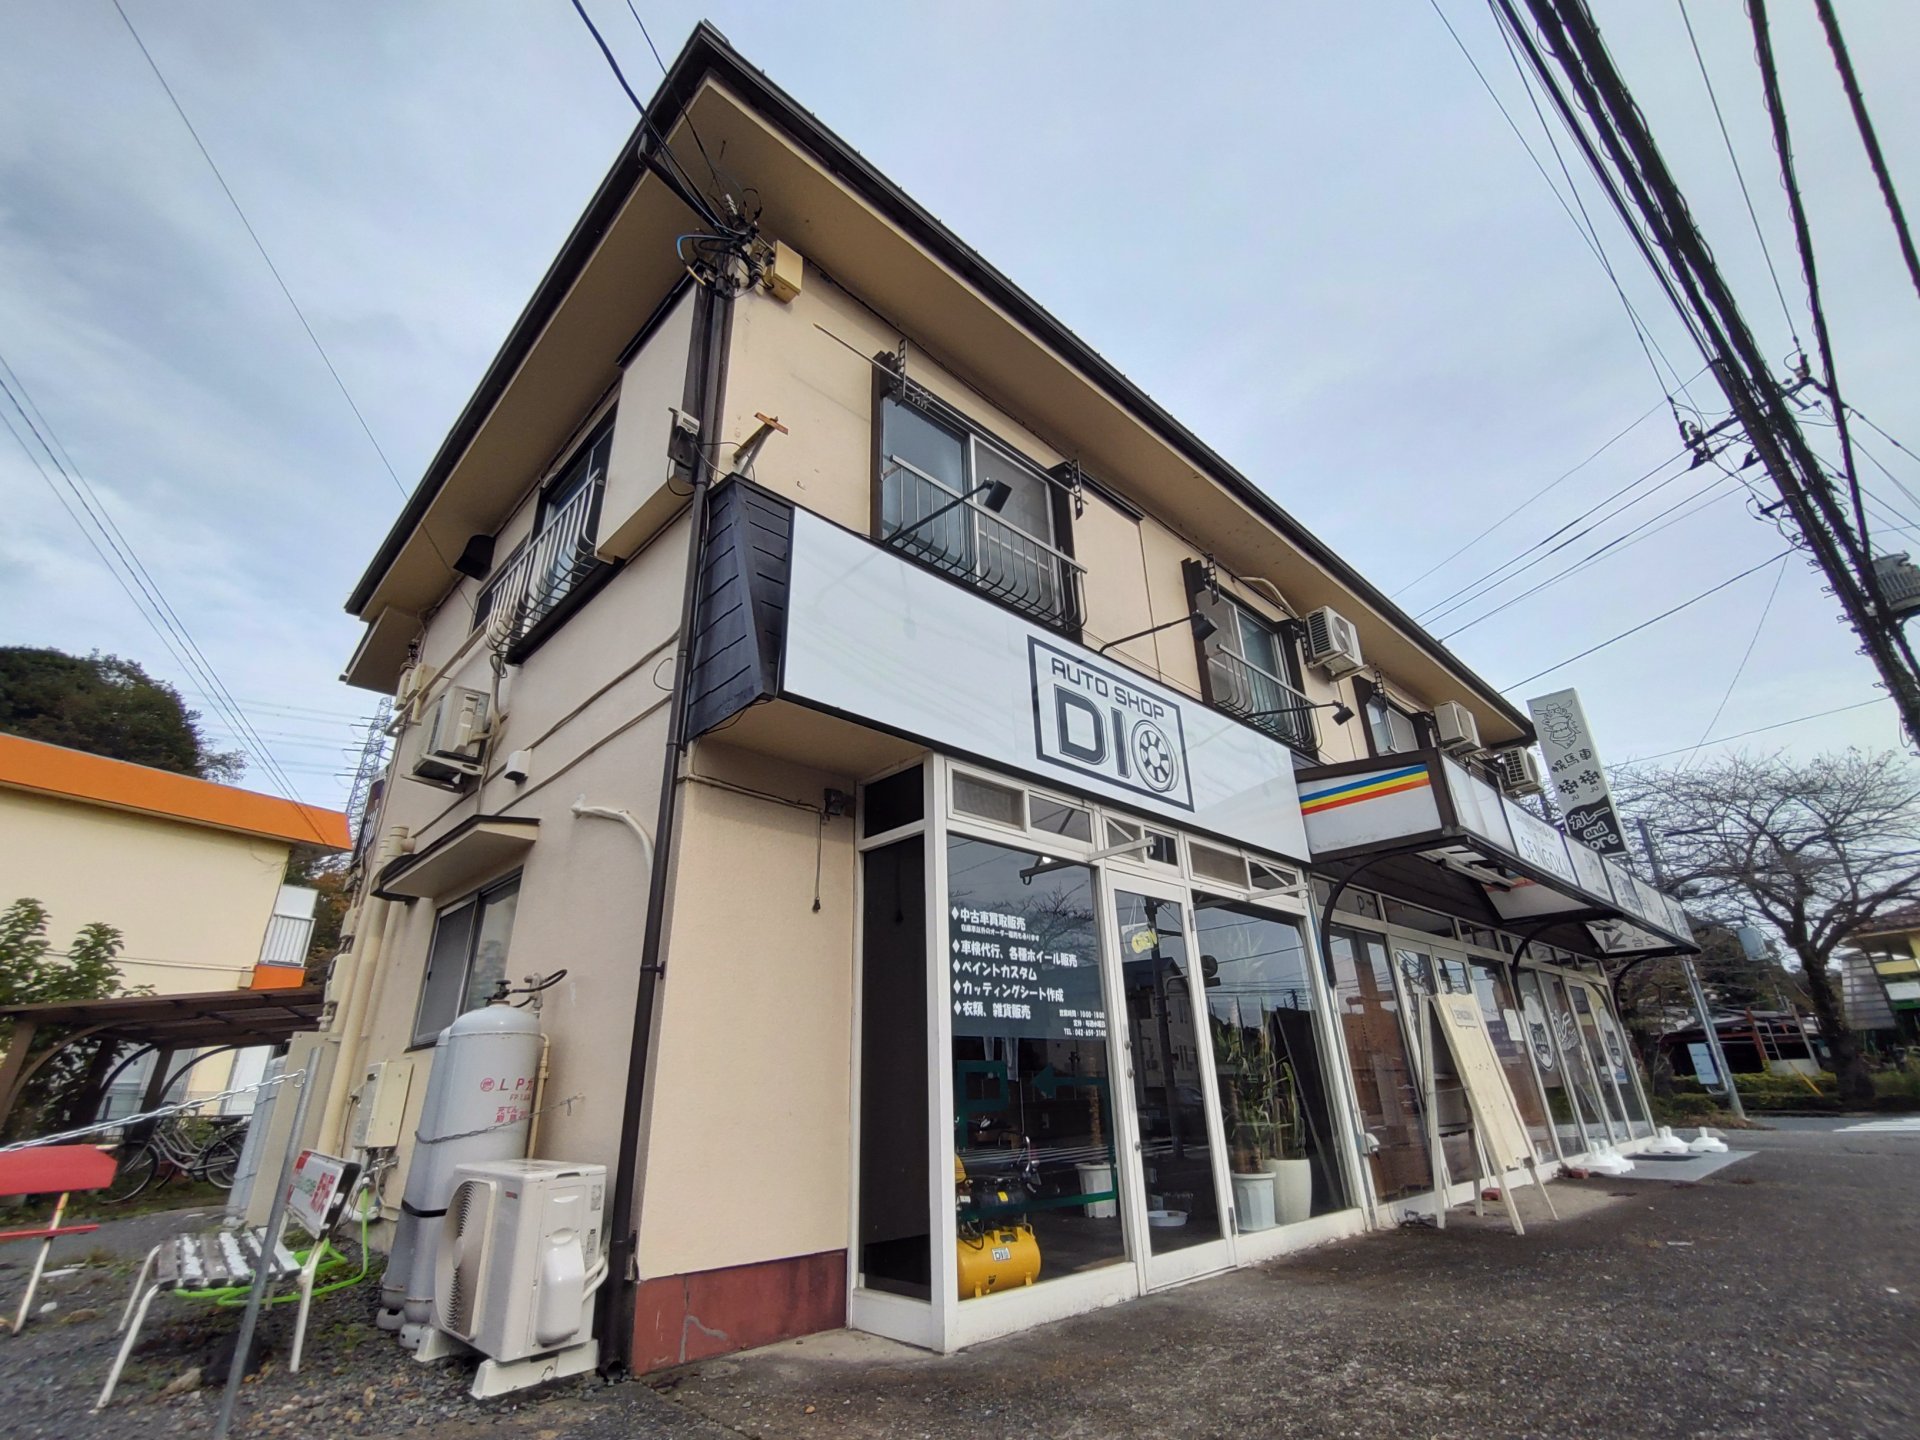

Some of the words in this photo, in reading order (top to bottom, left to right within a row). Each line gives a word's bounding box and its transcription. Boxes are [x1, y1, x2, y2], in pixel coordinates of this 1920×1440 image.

[1051, 657, 1108, 697] AUTO
[1114, 686, 1164, 720] SHOP
[1569, 807, 1610, 830] カレー
[1584, 821, 1608, 839] and
[960, 907, 1026, 930] 中古車買取販売
[962, 961, 1038, 981] ペイントカスタム
[962, 980, 1064, 1002] カッティングシート作成
